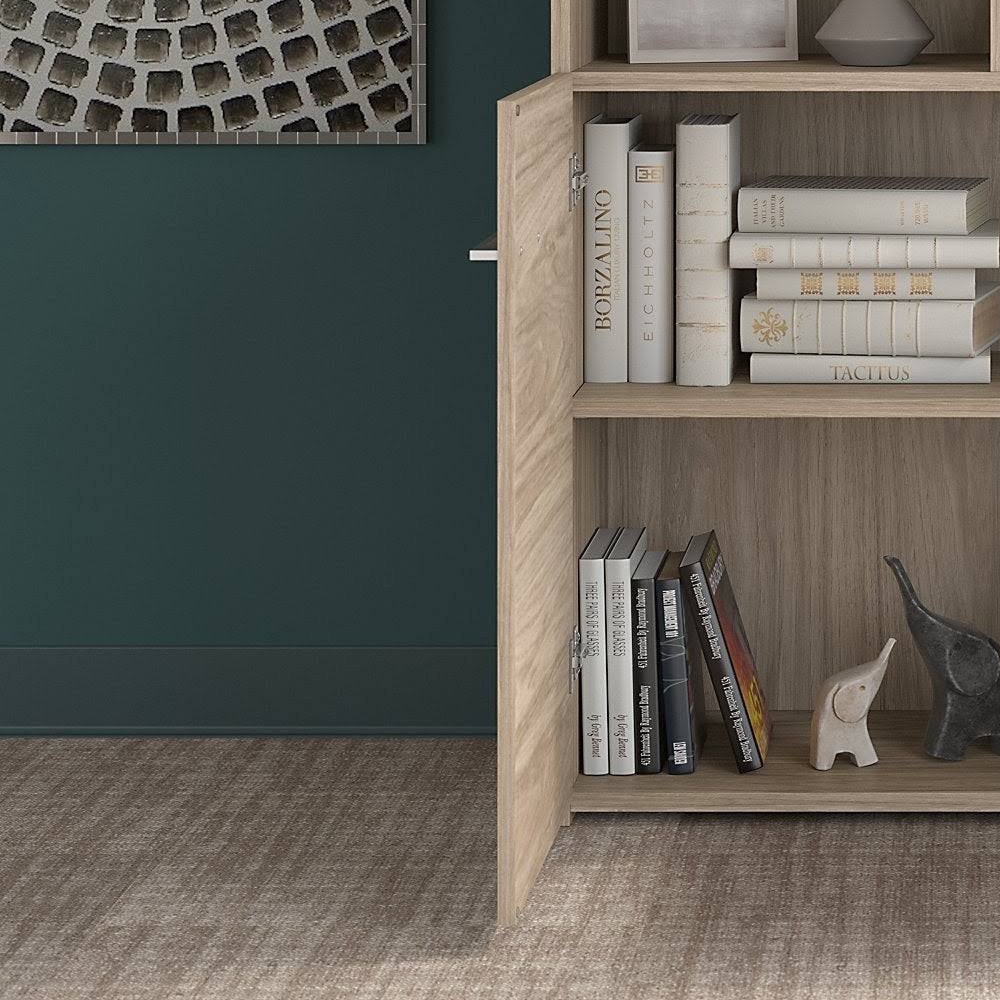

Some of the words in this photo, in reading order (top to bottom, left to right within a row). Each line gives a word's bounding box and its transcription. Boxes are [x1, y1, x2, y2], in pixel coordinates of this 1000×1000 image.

[594, 189, 612, 331] BORZALINO
[643, 199, 654, 341] EICHHOLTZ
[830, 365, 910, 381] TACITUS
[585, 581, 598, 599] THREE
[611, 581, 625, 599] THREE
[635, 587, 649, 608] Bradbury
[585, 602, 599, 619] PAIRS
[611, 602, 626, 619] PAIRS
[636, 608, 649, 629] Raymond
[586, 620, 599, 629] OF
[612, 620, 626, 629] OF
[586, 631, 600, 657] GLASSES
[612, 631, 626, 657] GLASSES
[637, 660, 648, 669] 451
[639, 685, 651, 705] Bradbury
[640, 705, 652, 726] Raymond
[640, 758, 652, 766] 451
